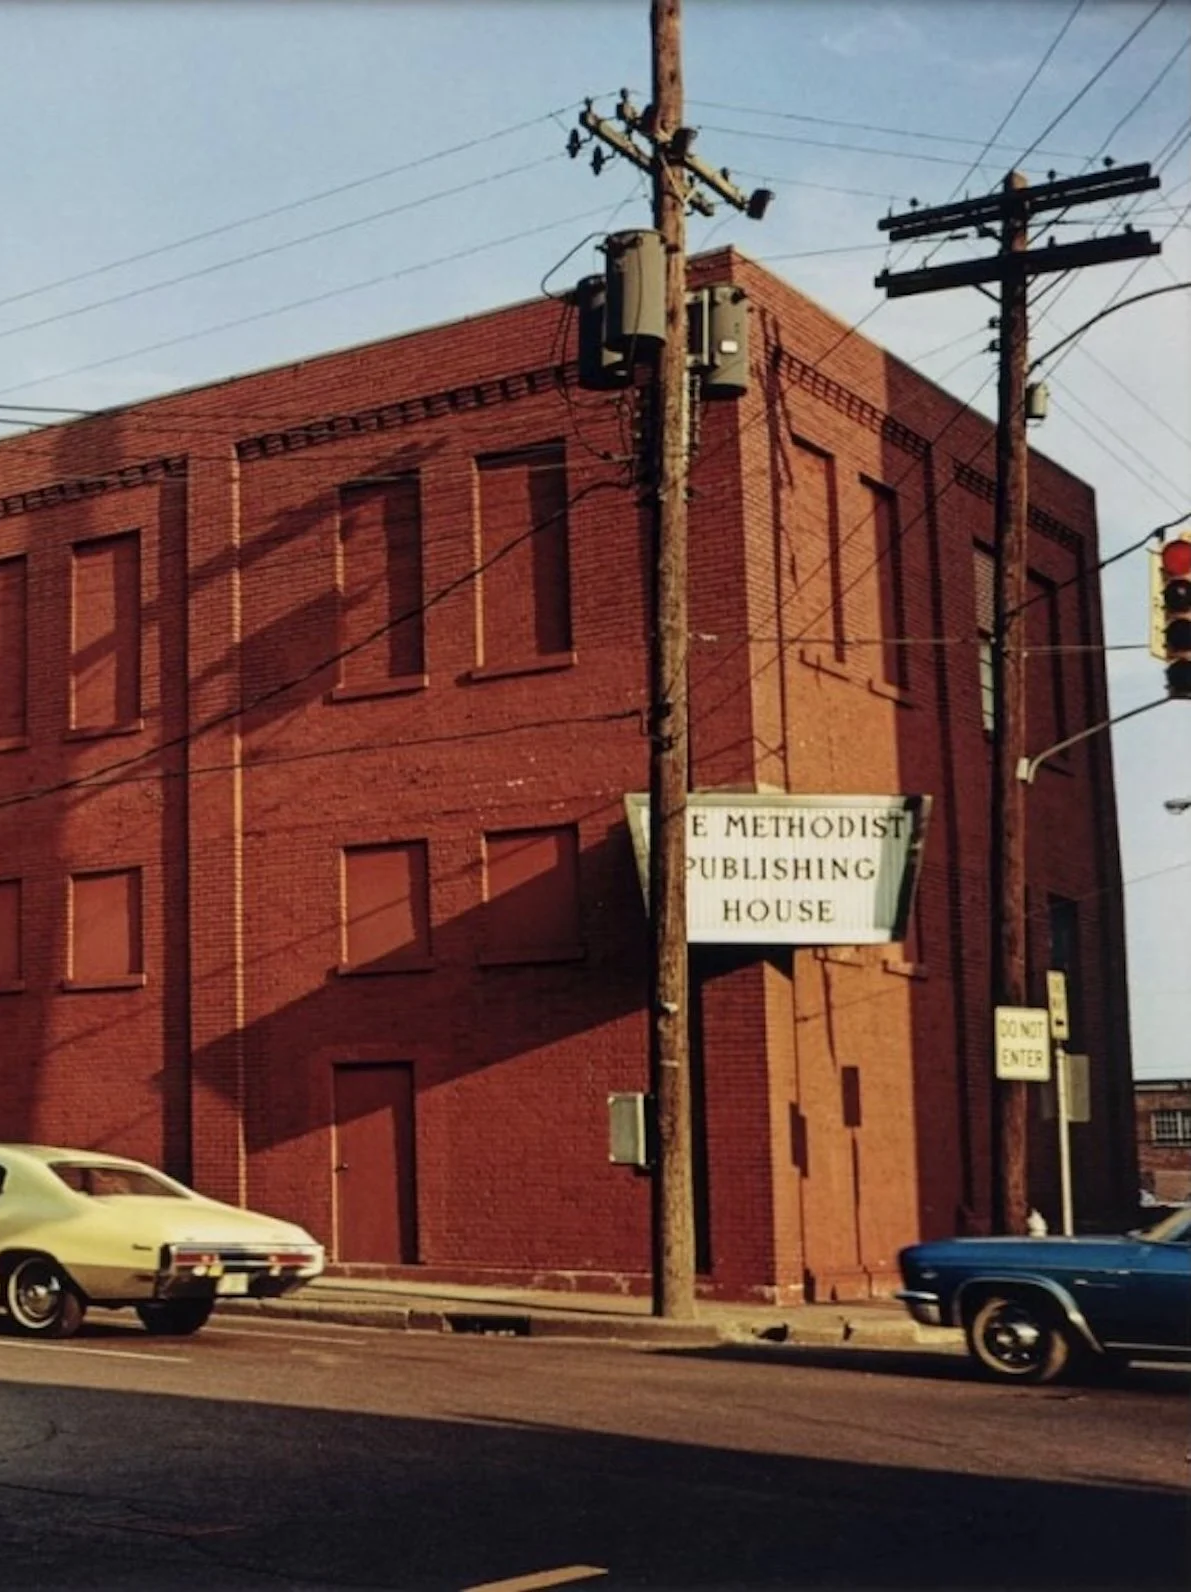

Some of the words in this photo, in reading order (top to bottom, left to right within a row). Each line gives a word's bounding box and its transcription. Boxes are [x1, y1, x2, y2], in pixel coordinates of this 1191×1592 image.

[725, 814, 905, 838] METHODIST
[723, 898, 836, 923] HOUSE
[999, 1019, 1017, 1038] DO
[1020, 1020, 1044, 1038] NOT
[1002, 1048, 1044, 1068] ENTER
